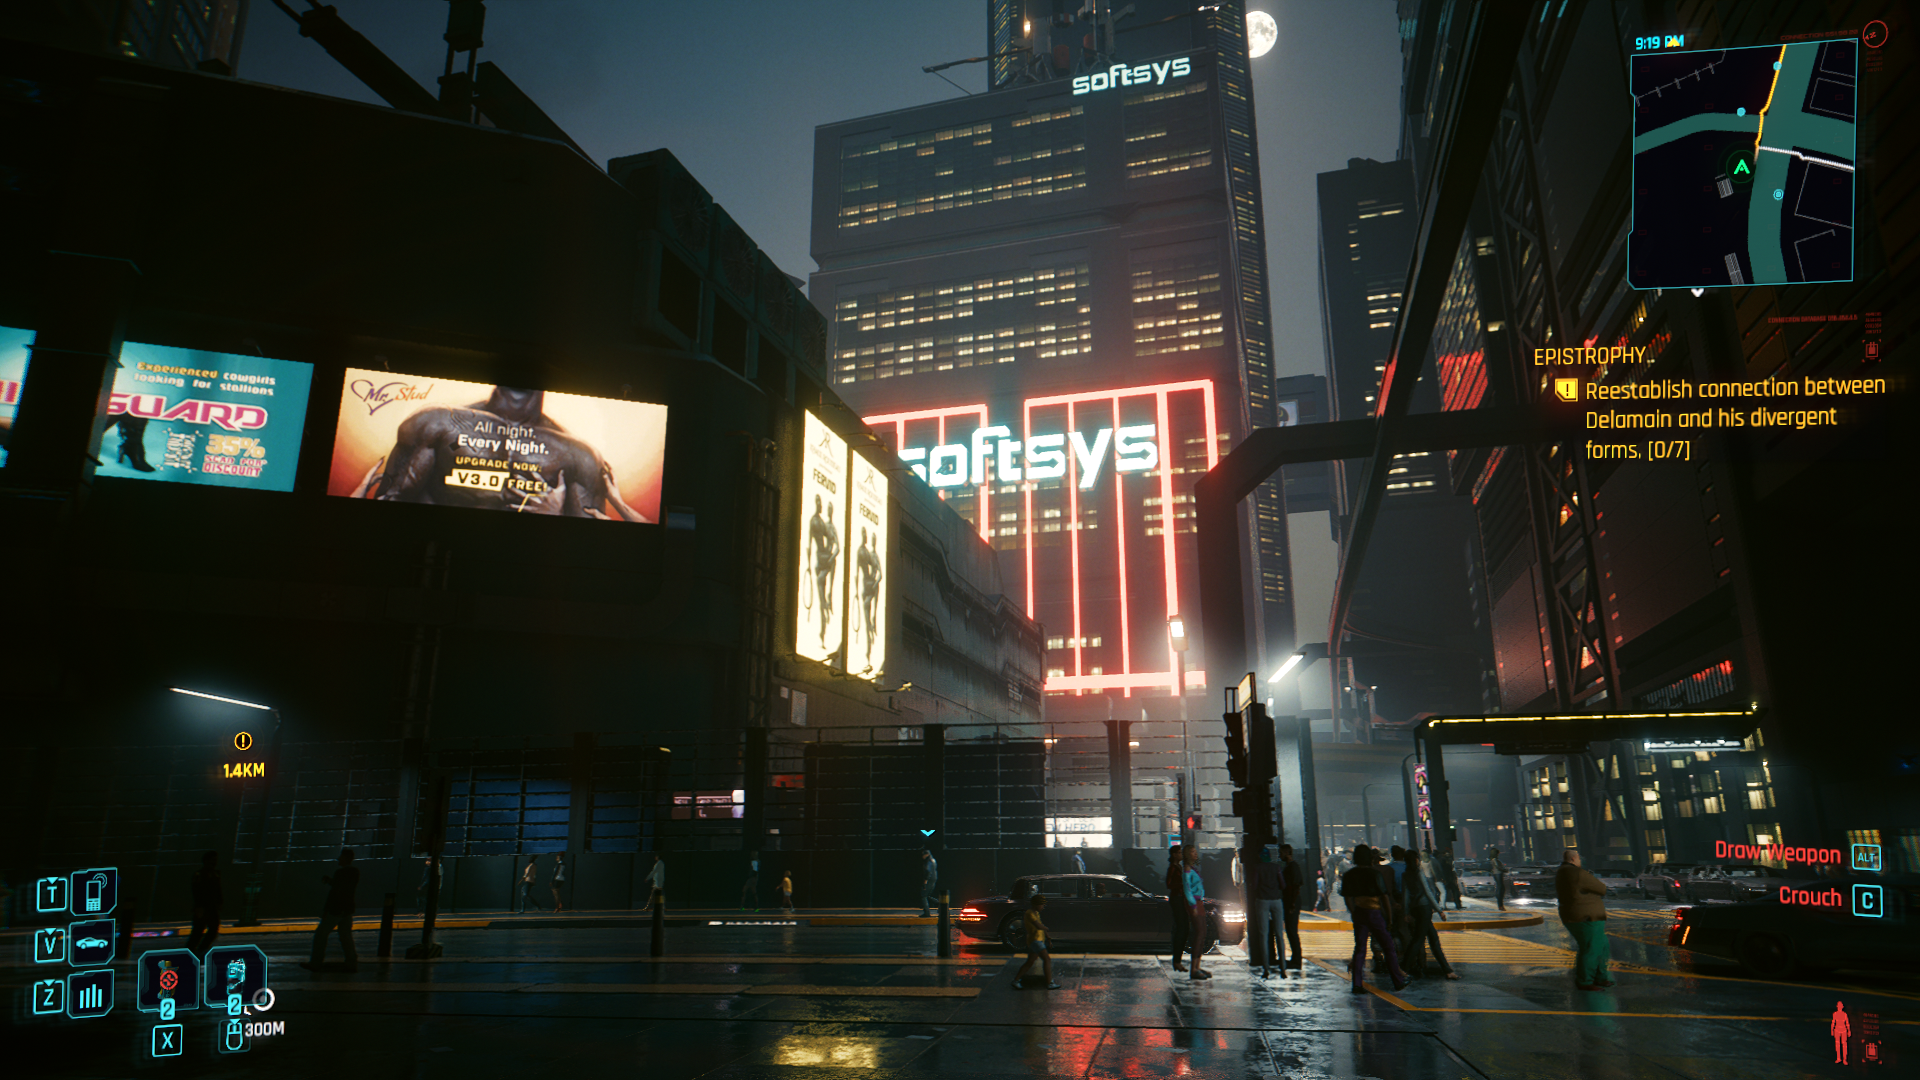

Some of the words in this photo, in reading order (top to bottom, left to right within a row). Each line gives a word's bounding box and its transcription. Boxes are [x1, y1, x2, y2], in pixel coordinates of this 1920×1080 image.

[1072, 57, 1191, 95] softsys
[133, 372, 185, 388] looking
[192, 378, 211, 389] for
[219, 382, 274, 396] stallions
[136, 361, 219, 379] Experienced
[223, 371, 276, 386] cowgirls
[395, 384, 434, 401] Stud
[474, 420, 493, 433] All
[496, 422, 536, 439] night.
[205, 434, 266, 458] 35%
[457, 434, 501, 452] Every
[505, 438, 549, 455] Night.
[455, 456, 509, 469] UPGRADE
[898, 423, 1158, 490] softsys
[202, 462, 263, 477] DISCOUNT
[457, 471, 500, 487] V3.0
[507, 478, 548, 493] FREE!
